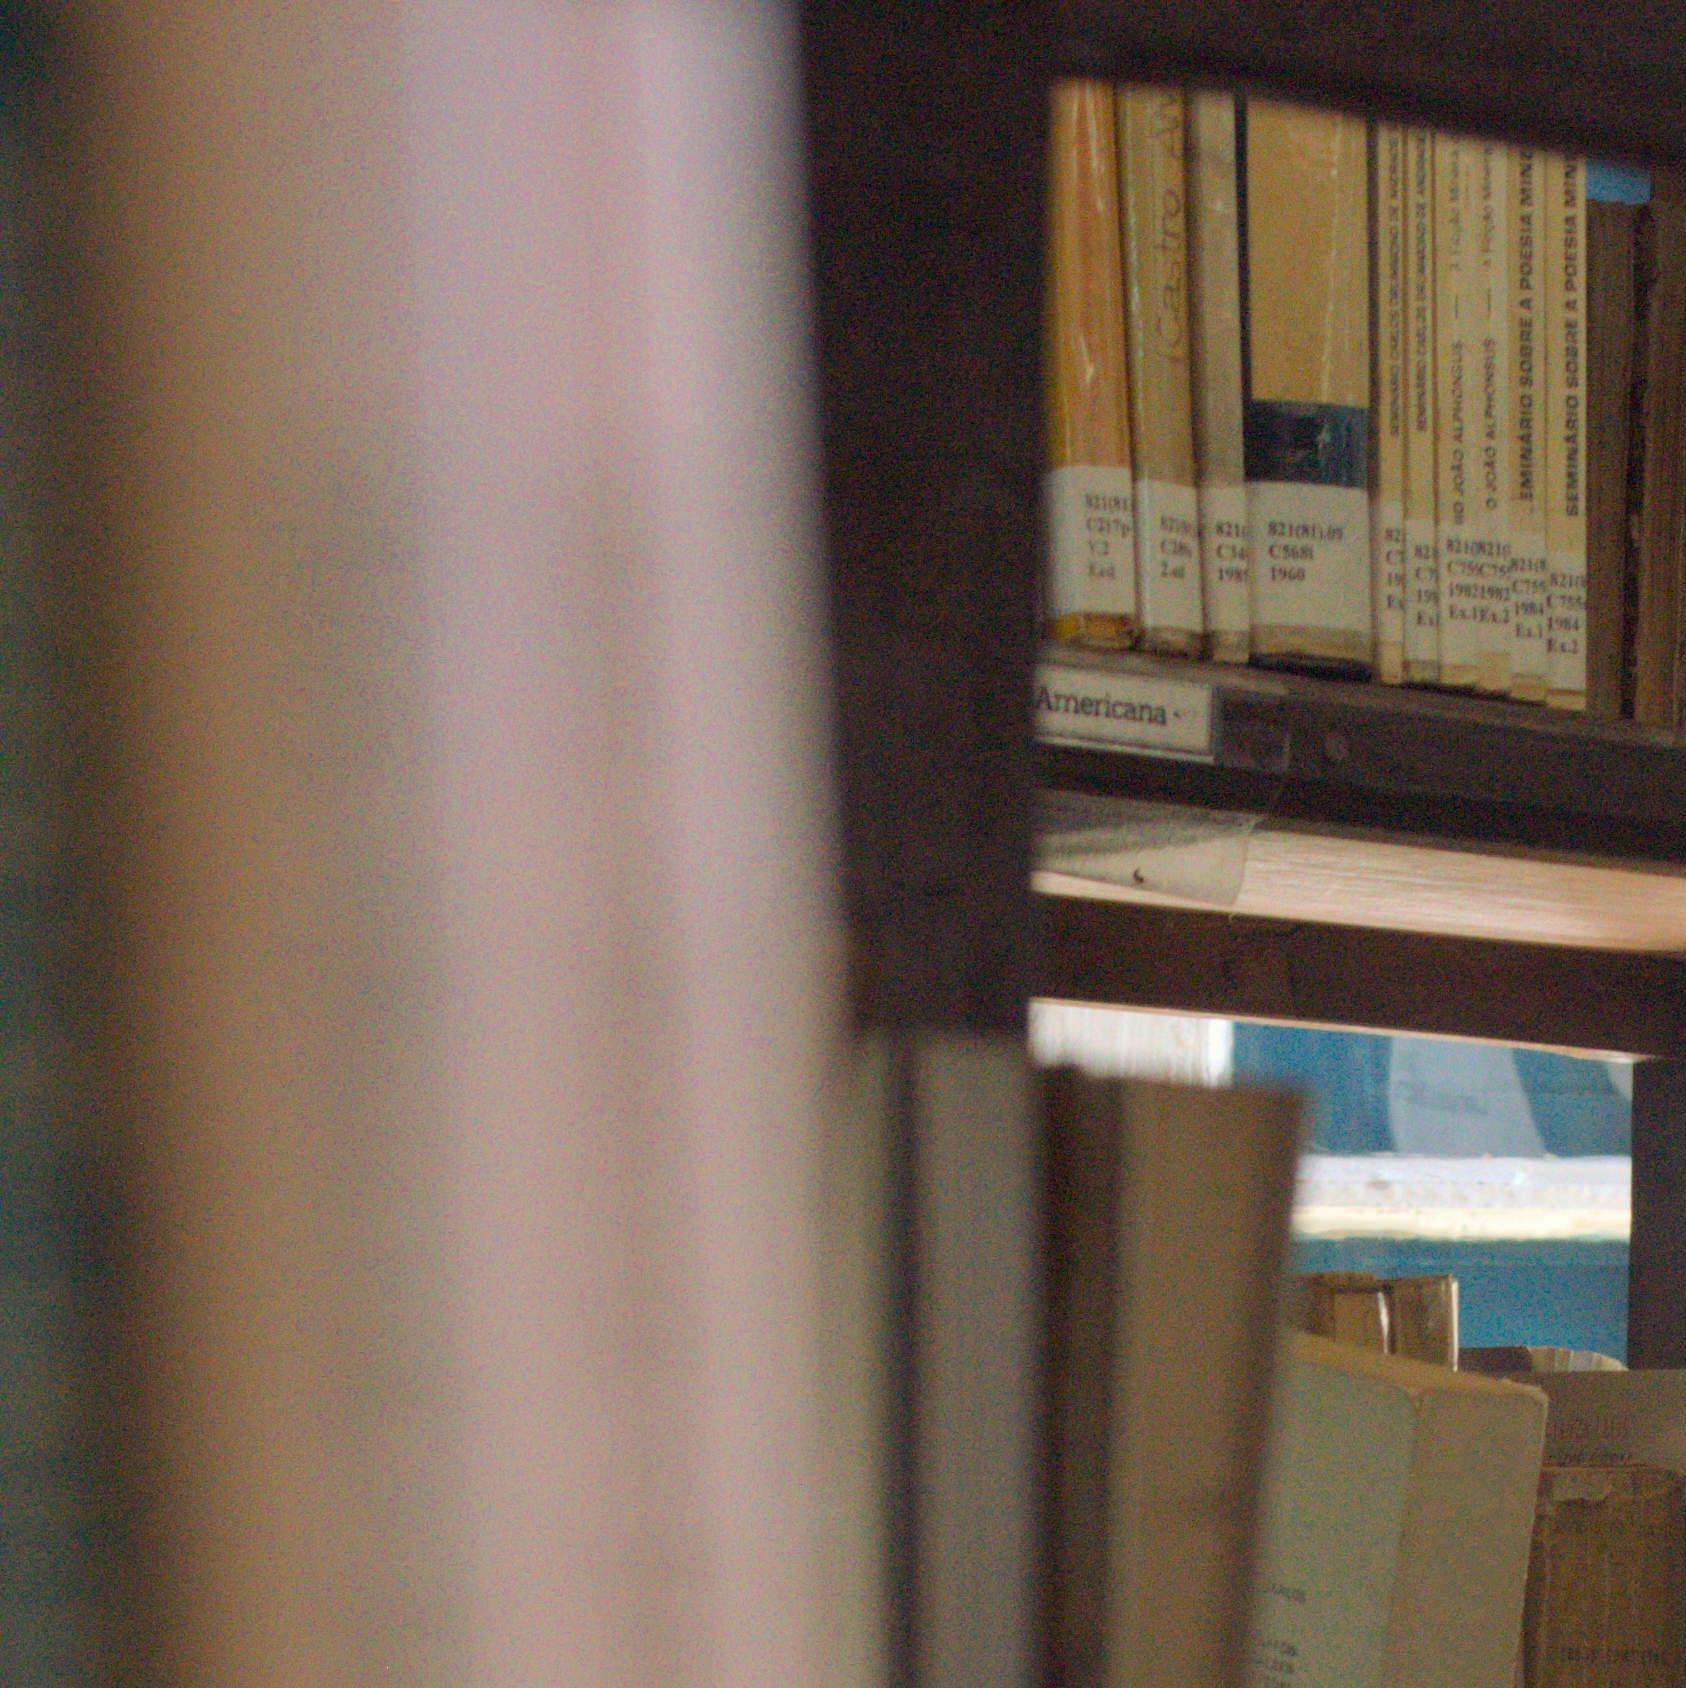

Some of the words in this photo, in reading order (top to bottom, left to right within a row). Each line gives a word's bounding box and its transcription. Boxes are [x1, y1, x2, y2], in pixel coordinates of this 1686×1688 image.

[1518, 212, 1534, 291] POESIA
[1562, 214, 1579, 293] POESIA
[1518, 297, 1534, 312] A
[1562, 299, 1579, 313] A
[1518, 317, 1534, 389] SOBRE
[1562, 318, 1580, 389] SOBRE
[1450, 340, 1464, 444] ALPHONSUS
[1482, 338, 1498, 442] ALPHONSUS
[1450, 449, 1464, 496] JOÃO
[1482, 446, 1498, 494] JOÃO
[1516, 394, 1534, 503] EMINÁRIO
[1562, 394, 1580, 517] SEMINÁRIO
[1036, 686, 1168, 725] Americana
